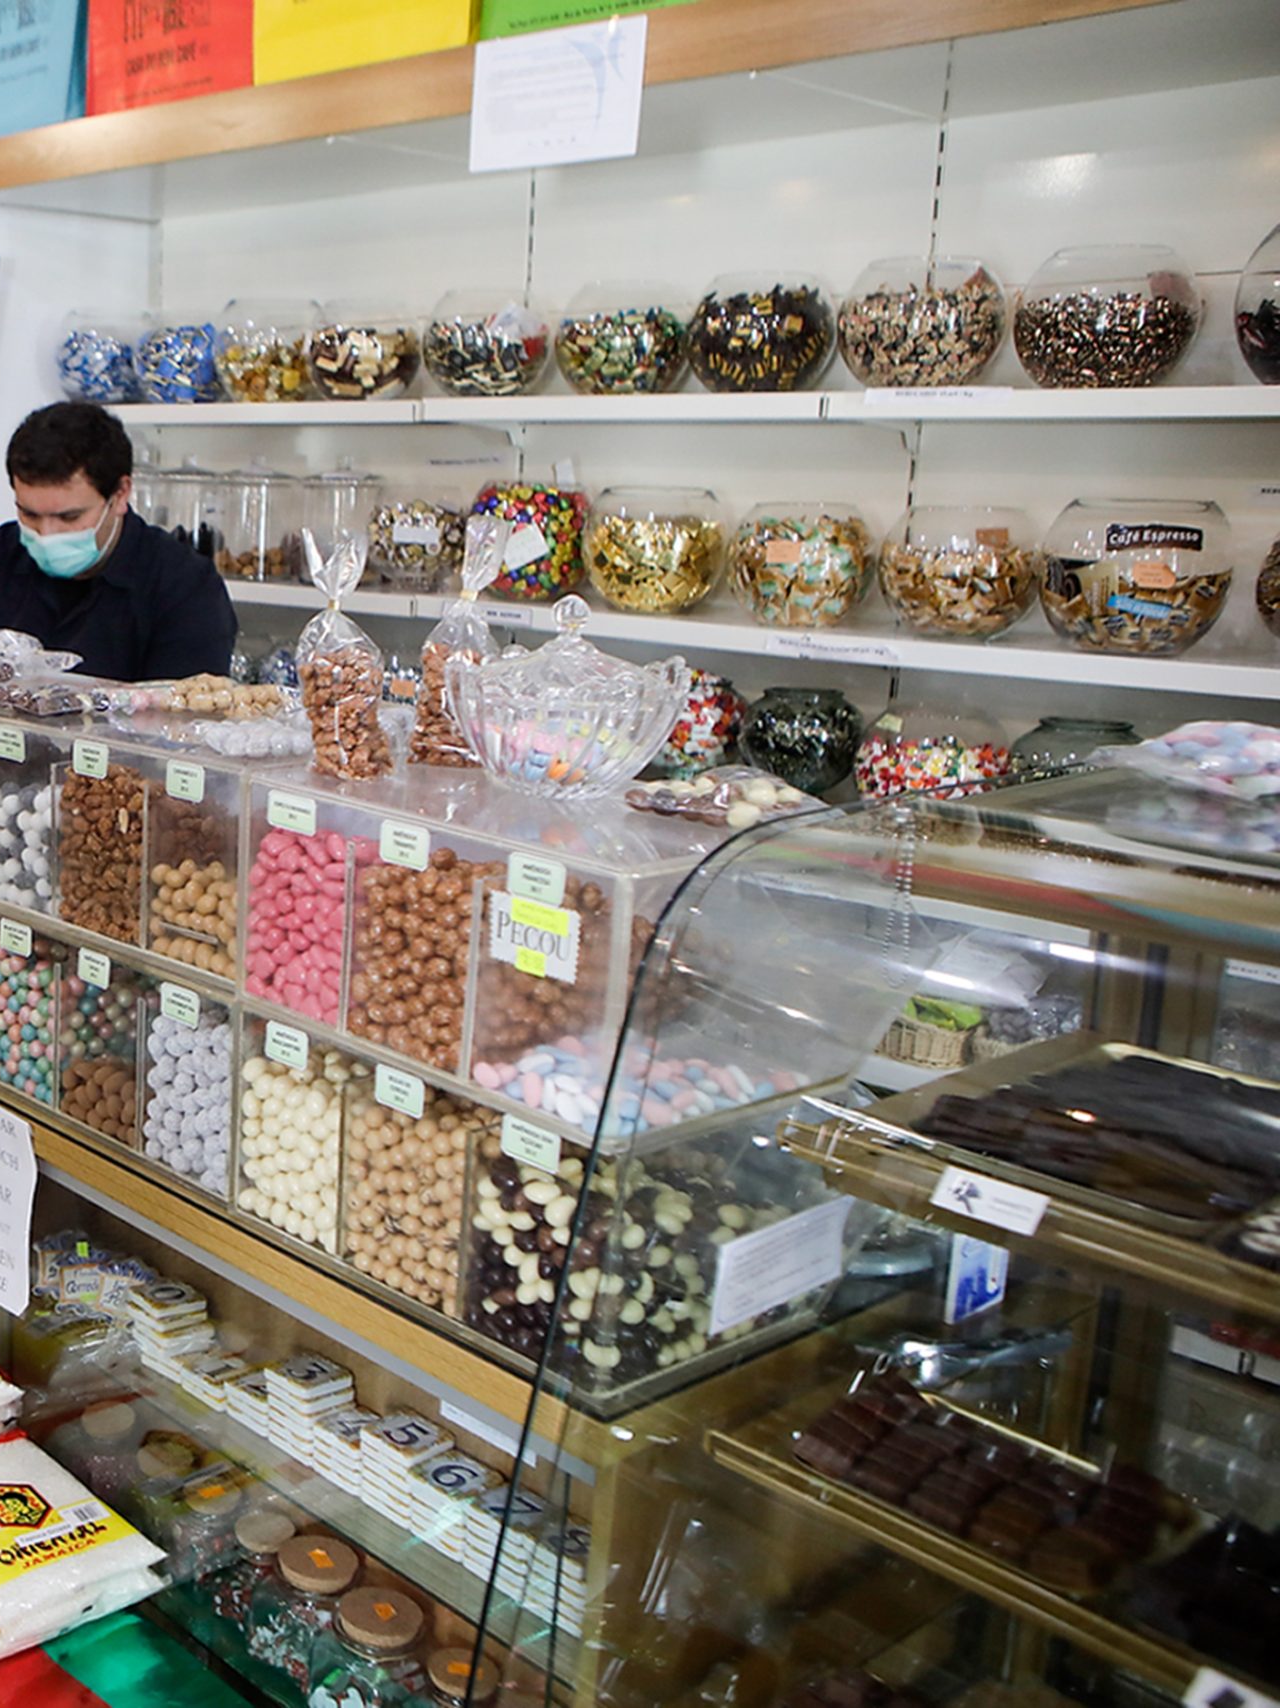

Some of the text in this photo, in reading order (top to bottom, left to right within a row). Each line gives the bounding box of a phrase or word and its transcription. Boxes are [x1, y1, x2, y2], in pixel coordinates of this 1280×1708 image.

[1110, 529, 1200, 545] Café Espresso
[287, 1362, 328, 1381] 3
[383, 1422, 429, 1446] 5
[431, 1464, 479, 1488] 6
[489, 1495, 543, 1514] 7
[23, 1538, 96, 1569] JAMAICA
